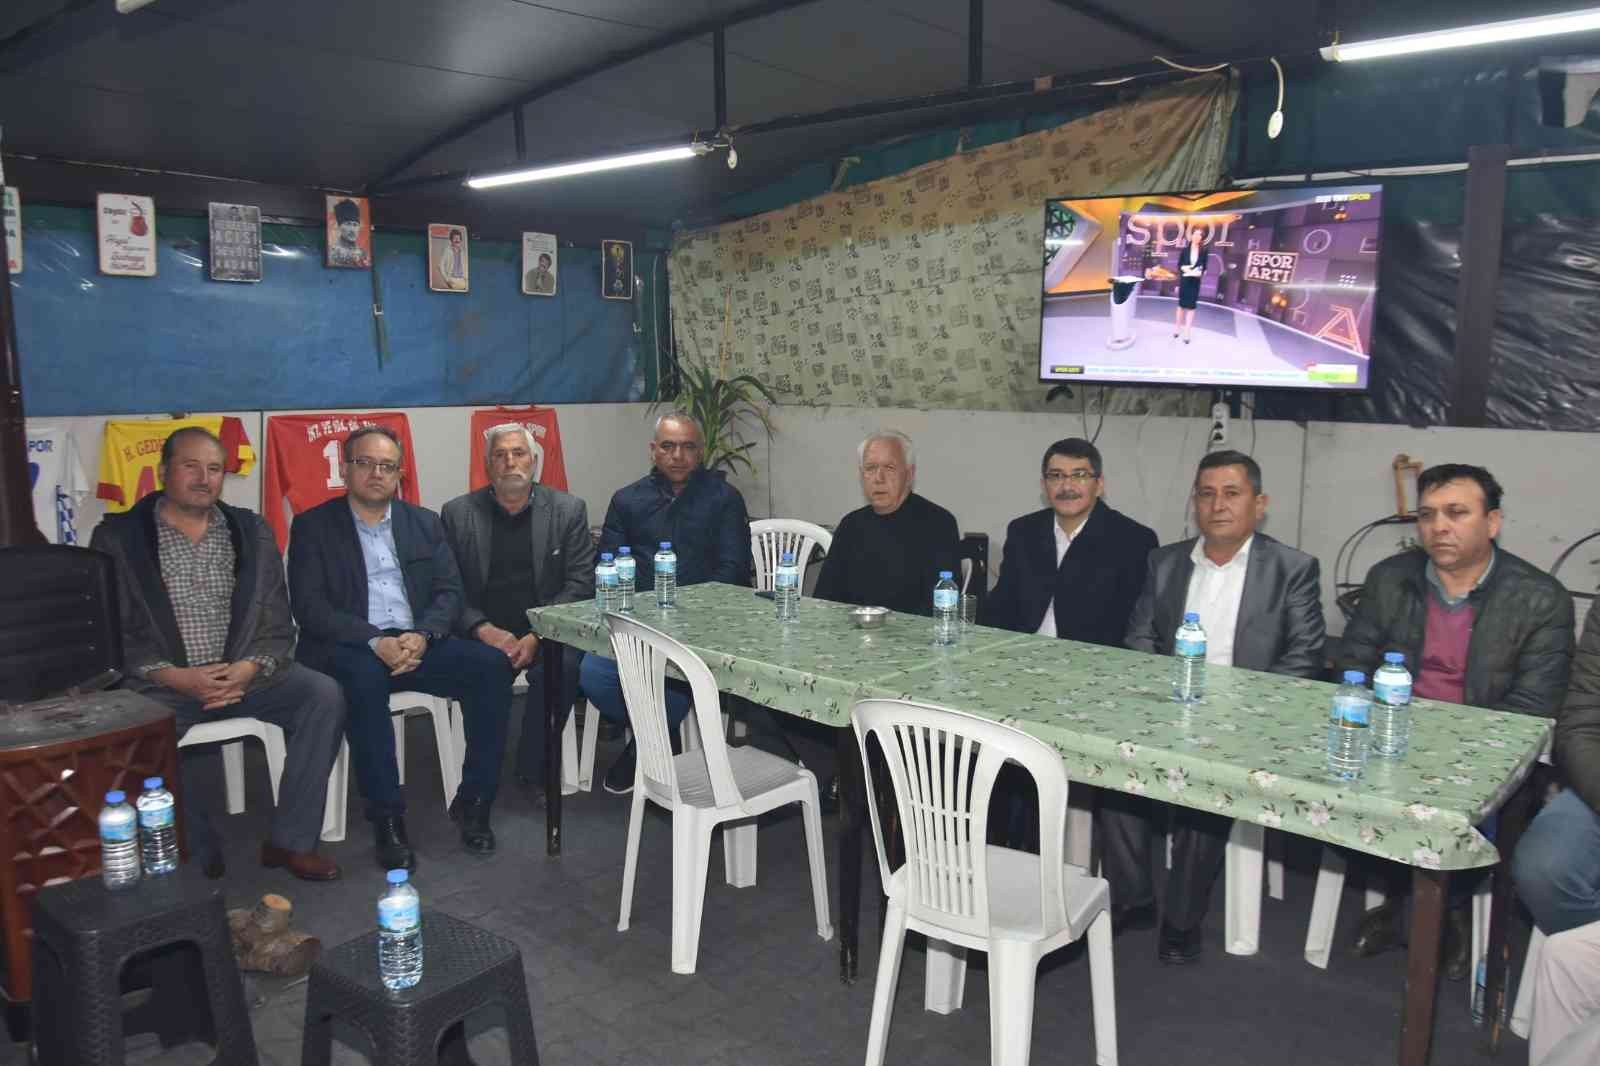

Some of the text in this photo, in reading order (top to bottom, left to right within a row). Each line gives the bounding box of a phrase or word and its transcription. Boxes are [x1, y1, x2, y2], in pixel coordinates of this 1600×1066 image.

[1251, 254, 1294, 269] SPOR
[1249, 266, 1290, 283] ARTI
[28, 439, 54, 453] POR
[322, 439, 346, 491] 1
